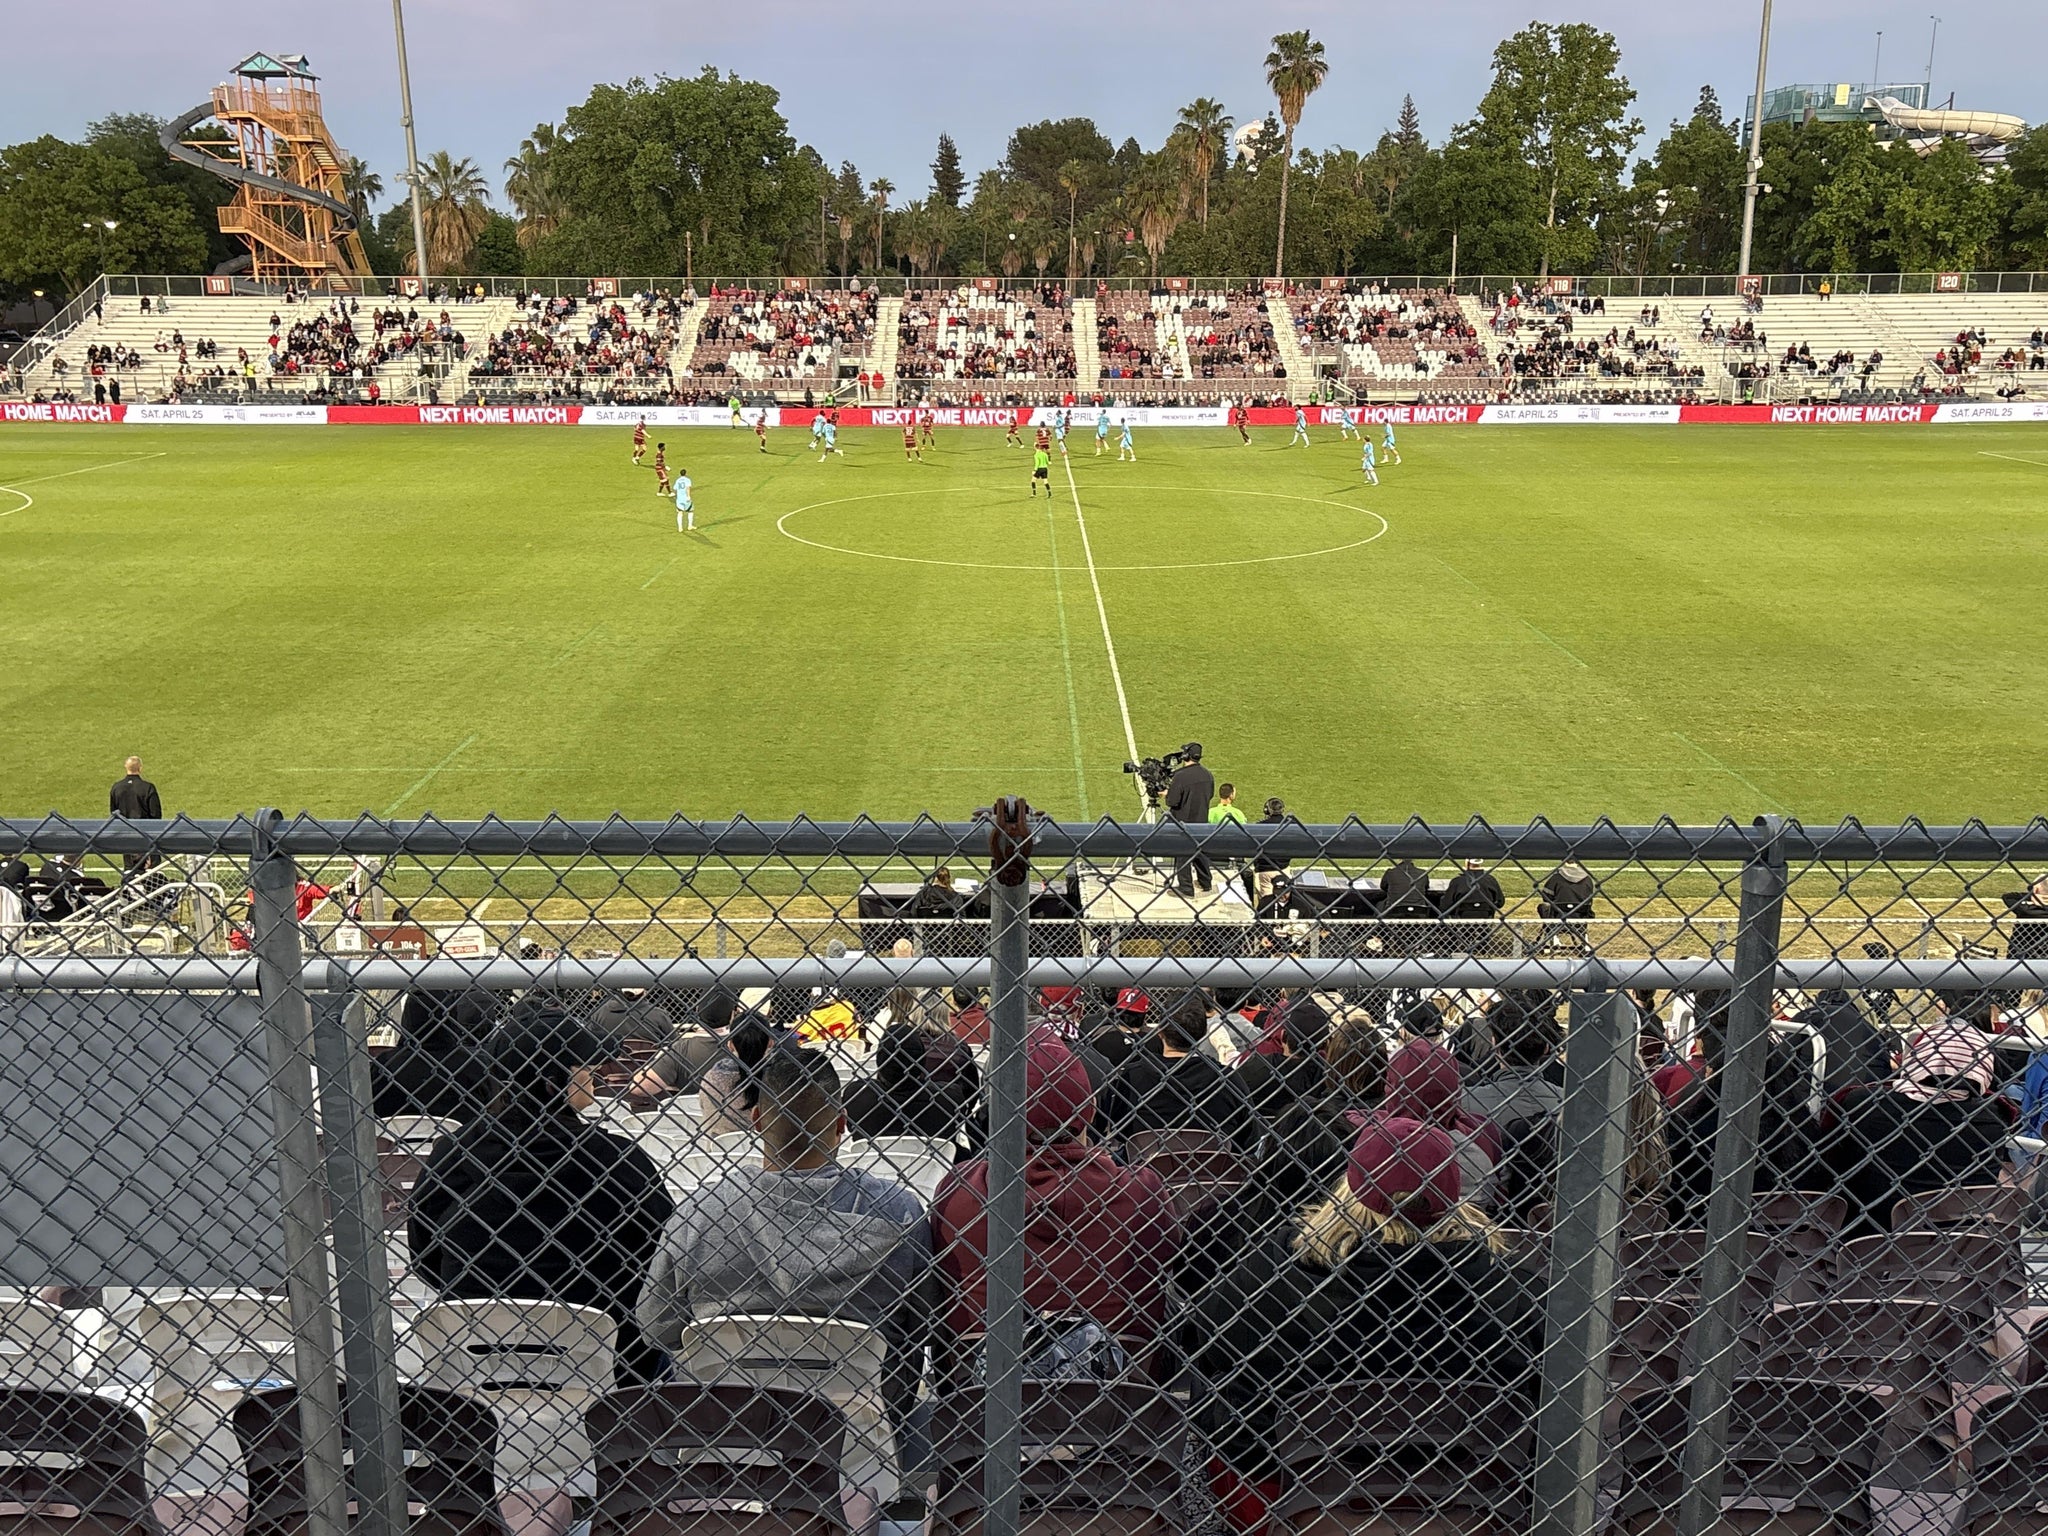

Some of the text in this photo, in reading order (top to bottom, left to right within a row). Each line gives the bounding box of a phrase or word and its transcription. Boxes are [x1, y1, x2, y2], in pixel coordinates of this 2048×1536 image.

[211, 279, 226, 292] 111
[1554, 280, 1569, 292] 118
[1940, 276, 1958, 288] 120
[4, 405, 52, 420] HOME
[55, 405, 111, 421] MATCH
[141, 409, 204, 419] SAT. APRIL 25
[419, 407, 567, 423] NEXT HOME MATCH
[596, 411, 616, 420] SAT.
[647, 411, 658, 420] 25
[872, 410, 913, 425] NEXT
[1365, 407, 1411, 423] HOME
[1413, 407, 1468, 423] MATCH
[1497, 410, 1558, 419] SAT. APRIL 25
[1771, 406, 1922, 422] NEXT HOME MATCH
[1951, 407, 2013, 418] SAT. APRIL 25
